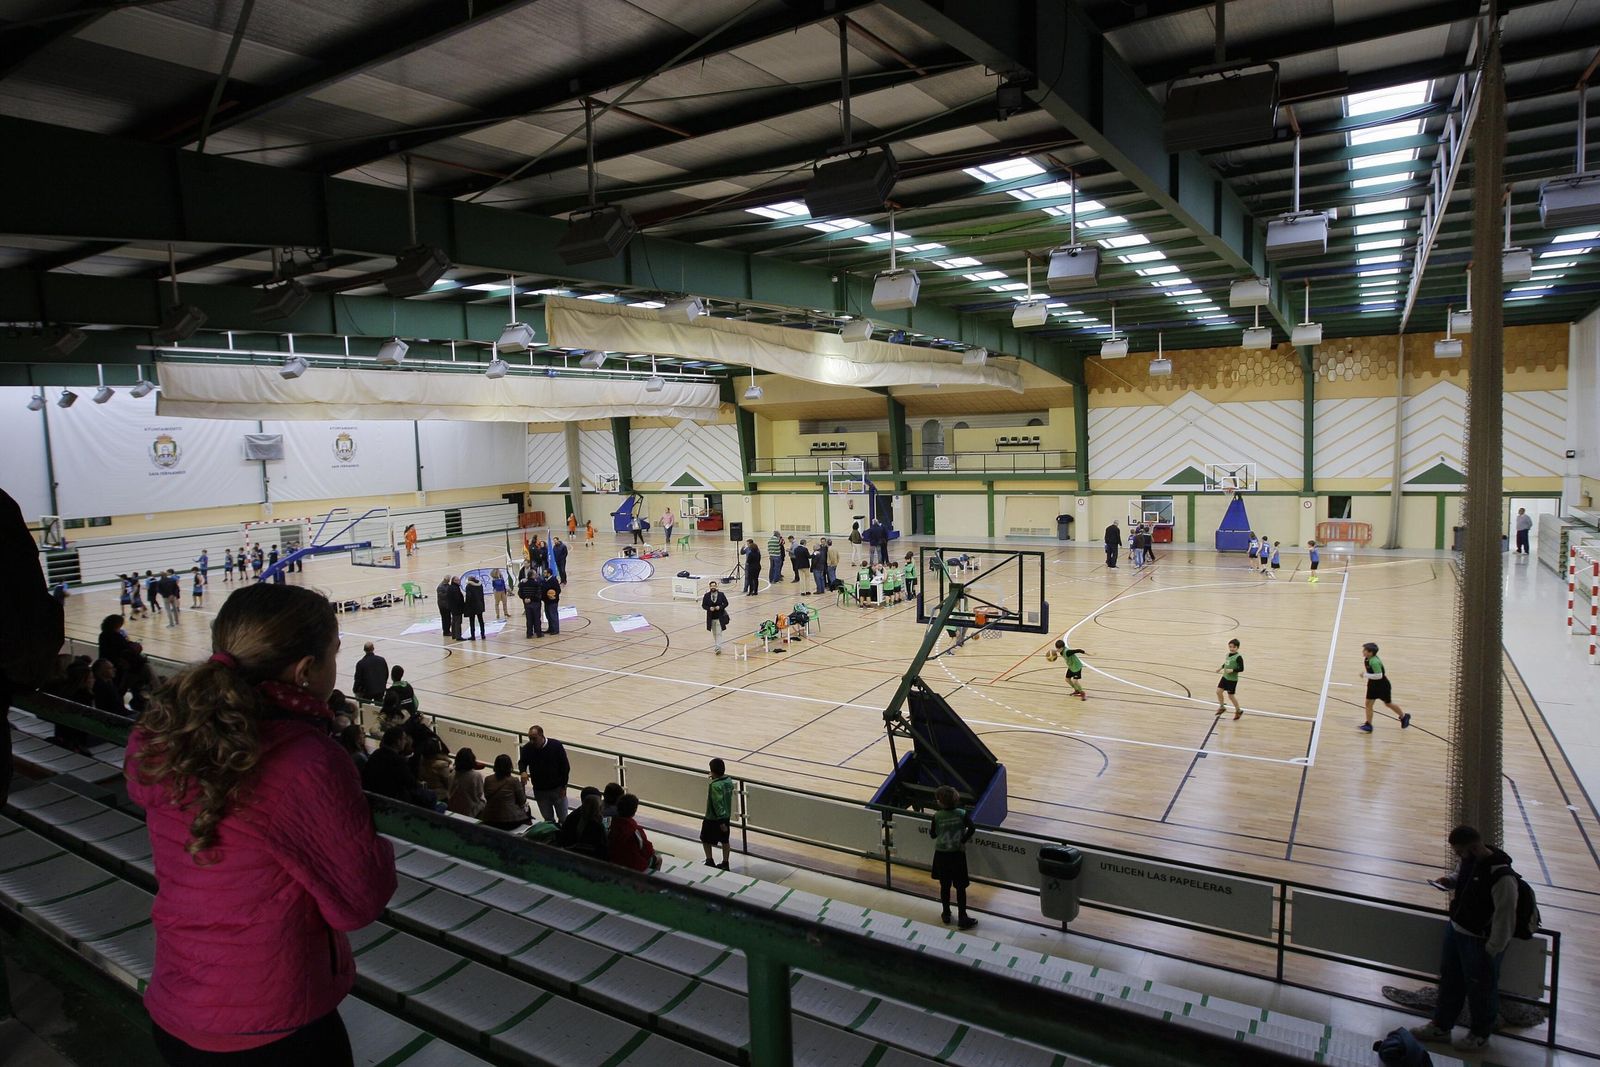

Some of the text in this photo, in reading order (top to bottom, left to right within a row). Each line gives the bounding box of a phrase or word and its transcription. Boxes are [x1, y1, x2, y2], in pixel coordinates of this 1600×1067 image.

[476, 733, 502, 743] PAPELERAS
[975, 838, 1026, 855] PAPELERAS
[1100, 862, 1232, 895] UTILICEN LAS PAPELERAS
